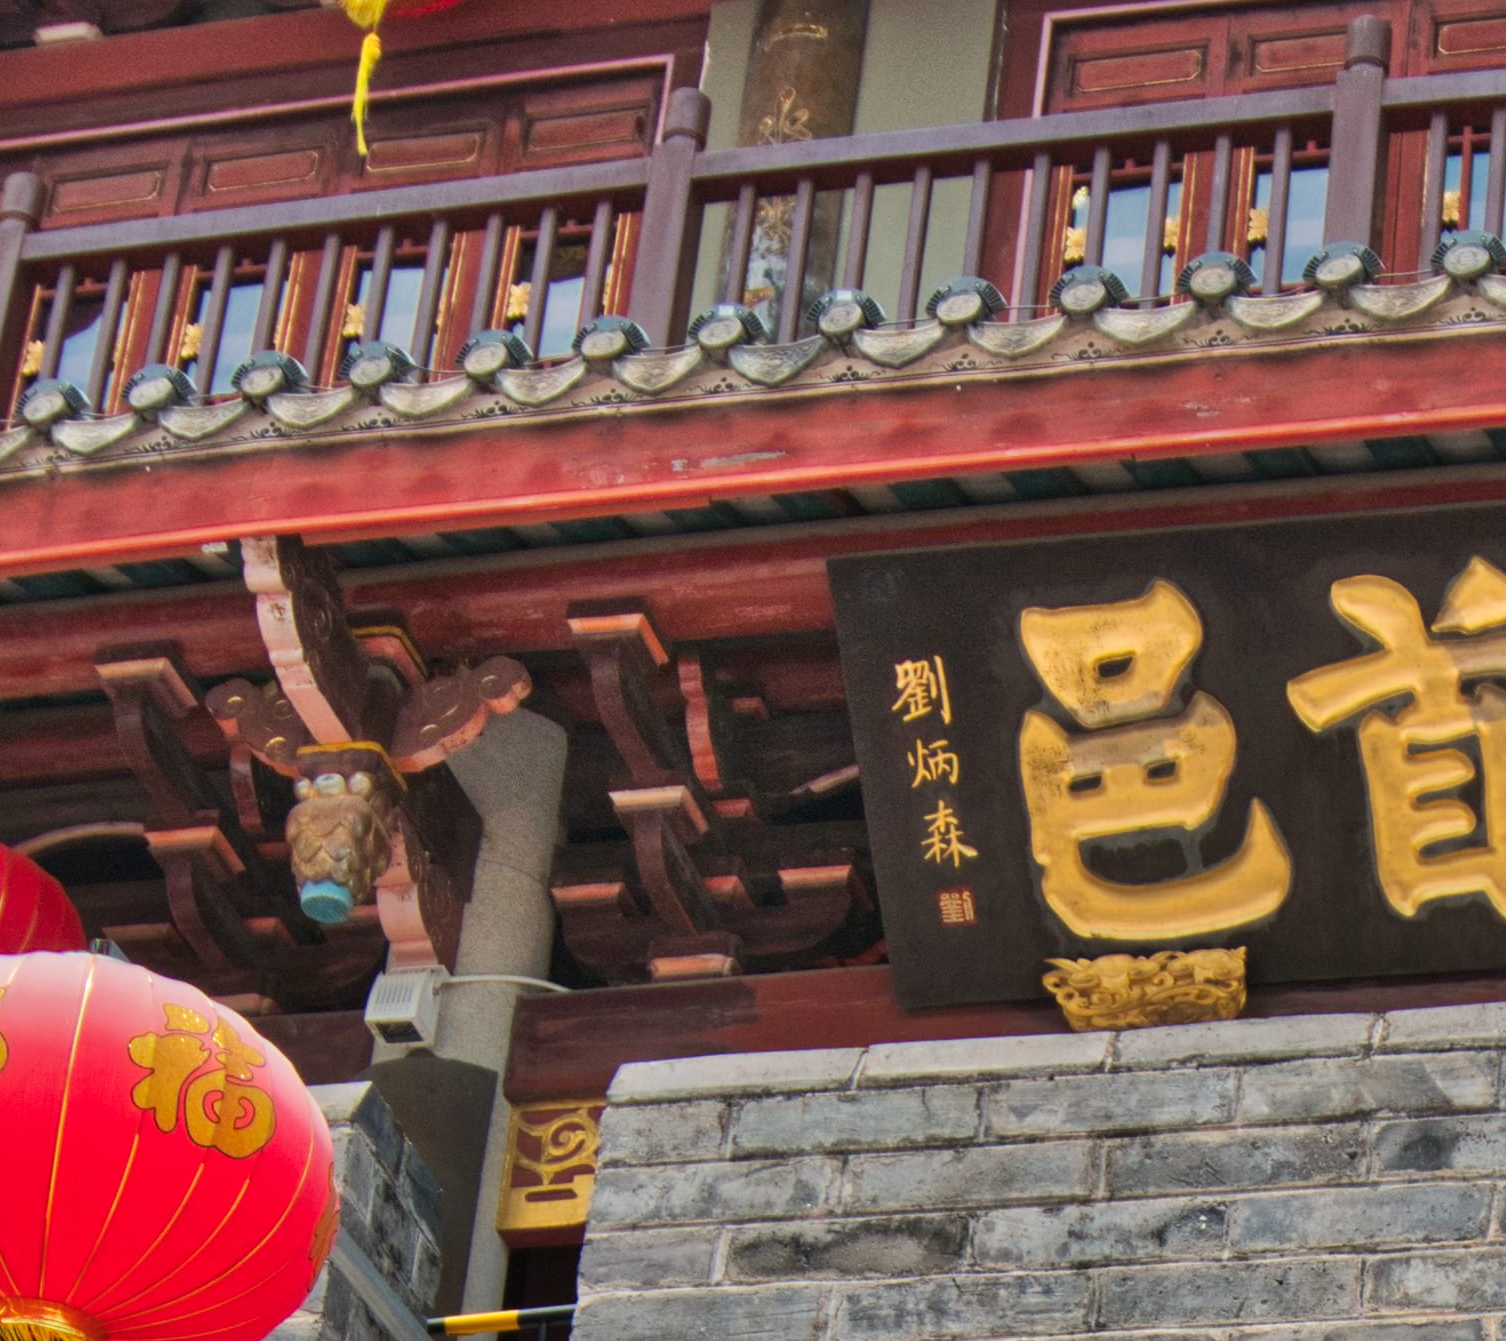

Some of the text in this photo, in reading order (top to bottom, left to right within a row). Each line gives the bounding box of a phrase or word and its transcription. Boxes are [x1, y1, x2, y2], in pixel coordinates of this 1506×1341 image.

[892, 655, 979, 868] 劉炳森
[127, 1003, 276, 1159] 福
